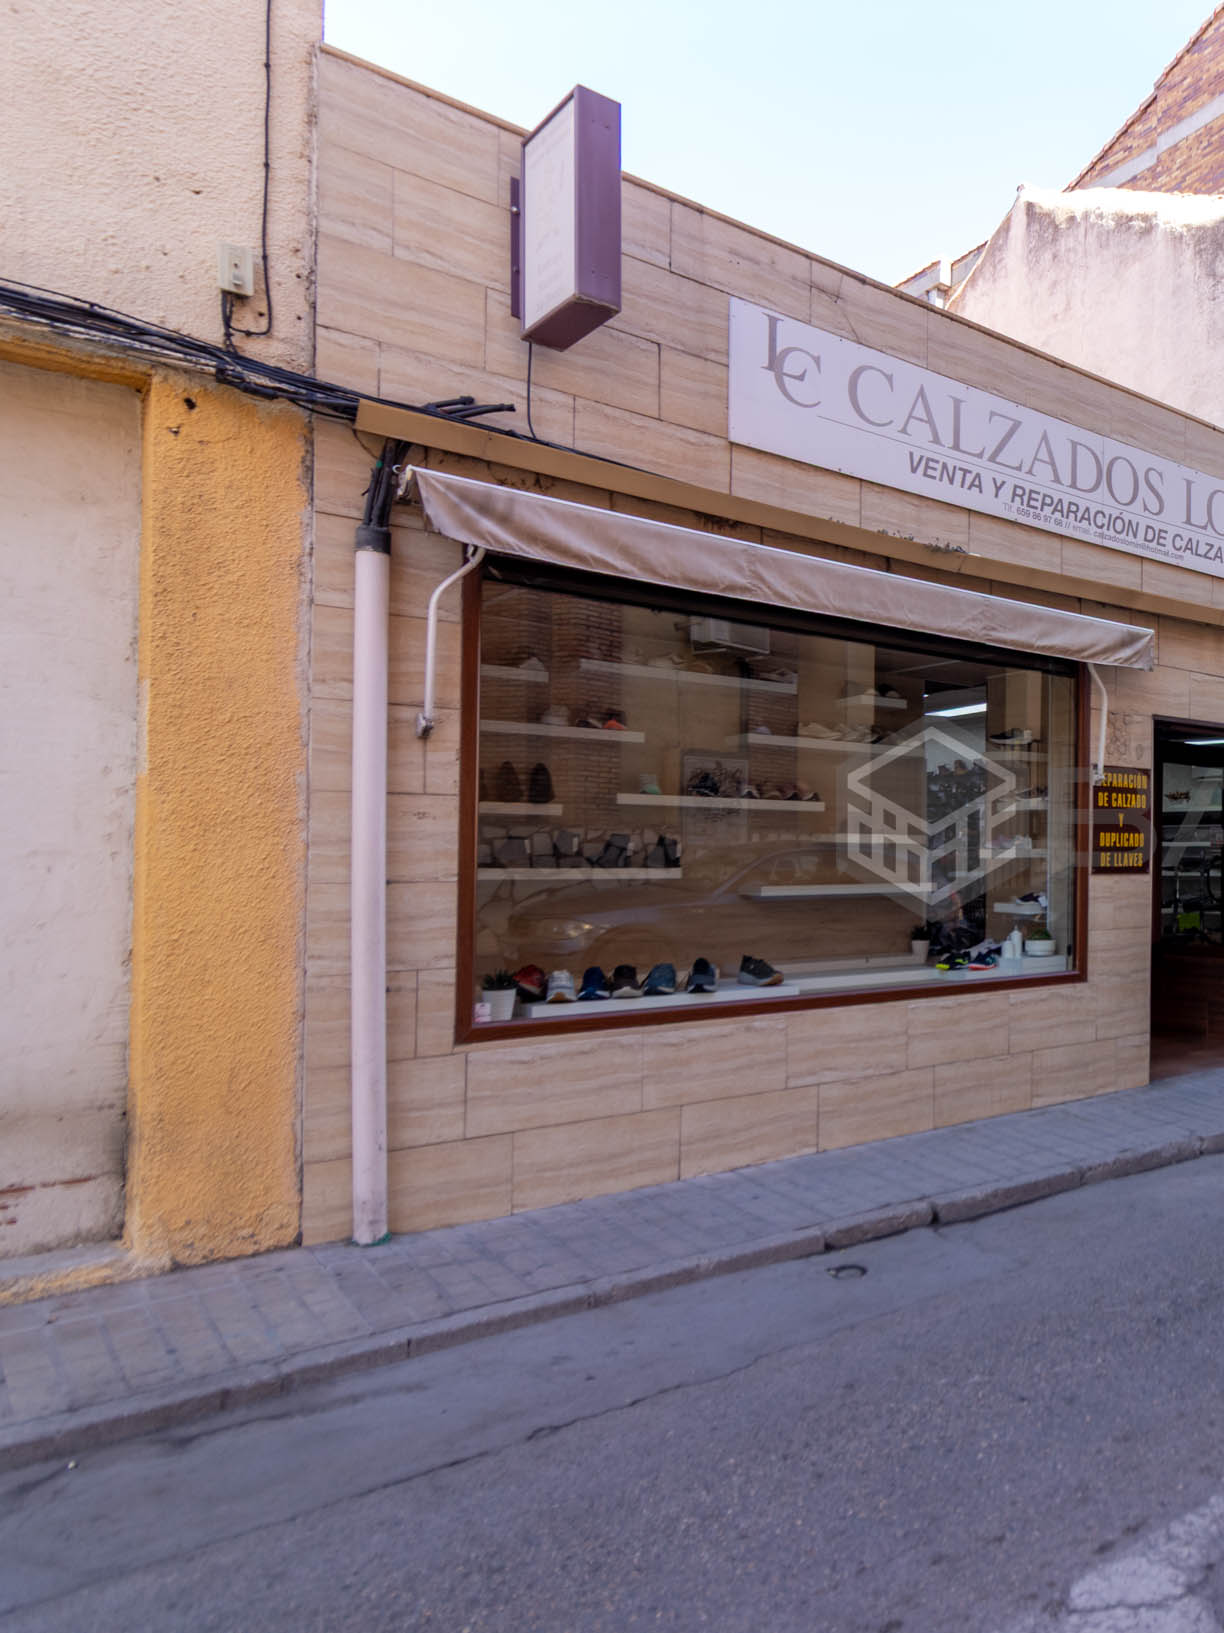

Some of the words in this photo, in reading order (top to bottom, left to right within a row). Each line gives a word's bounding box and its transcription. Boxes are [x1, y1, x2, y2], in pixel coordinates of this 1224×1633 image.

[848, 365, 1165, 516] CALZADOS
[908, 451, 983, 494] VENTA
[992, 477, 1006, 499] Y
[1011, 484, 1140, 540] REPARACIÓN
[1143, 525, 1169, 548] DE
[1016, 506, 1031, 519] 659
[1032, 512, 1042, 522] 86
[1053, 518, 1064, 528] 68
[1102, 772, 1148, 789] EPARACIÓN
[1098, 791, 1109, 807] DE
[1112, 793, 1146, 808] CALZADO
[1118, 813, 1125, 827] Y
[1099, 832, 1144, 847] DUPLICADO
[1100, 851, 1111, 867] DE
[1114, 852, 1144, 867] LLAVES
